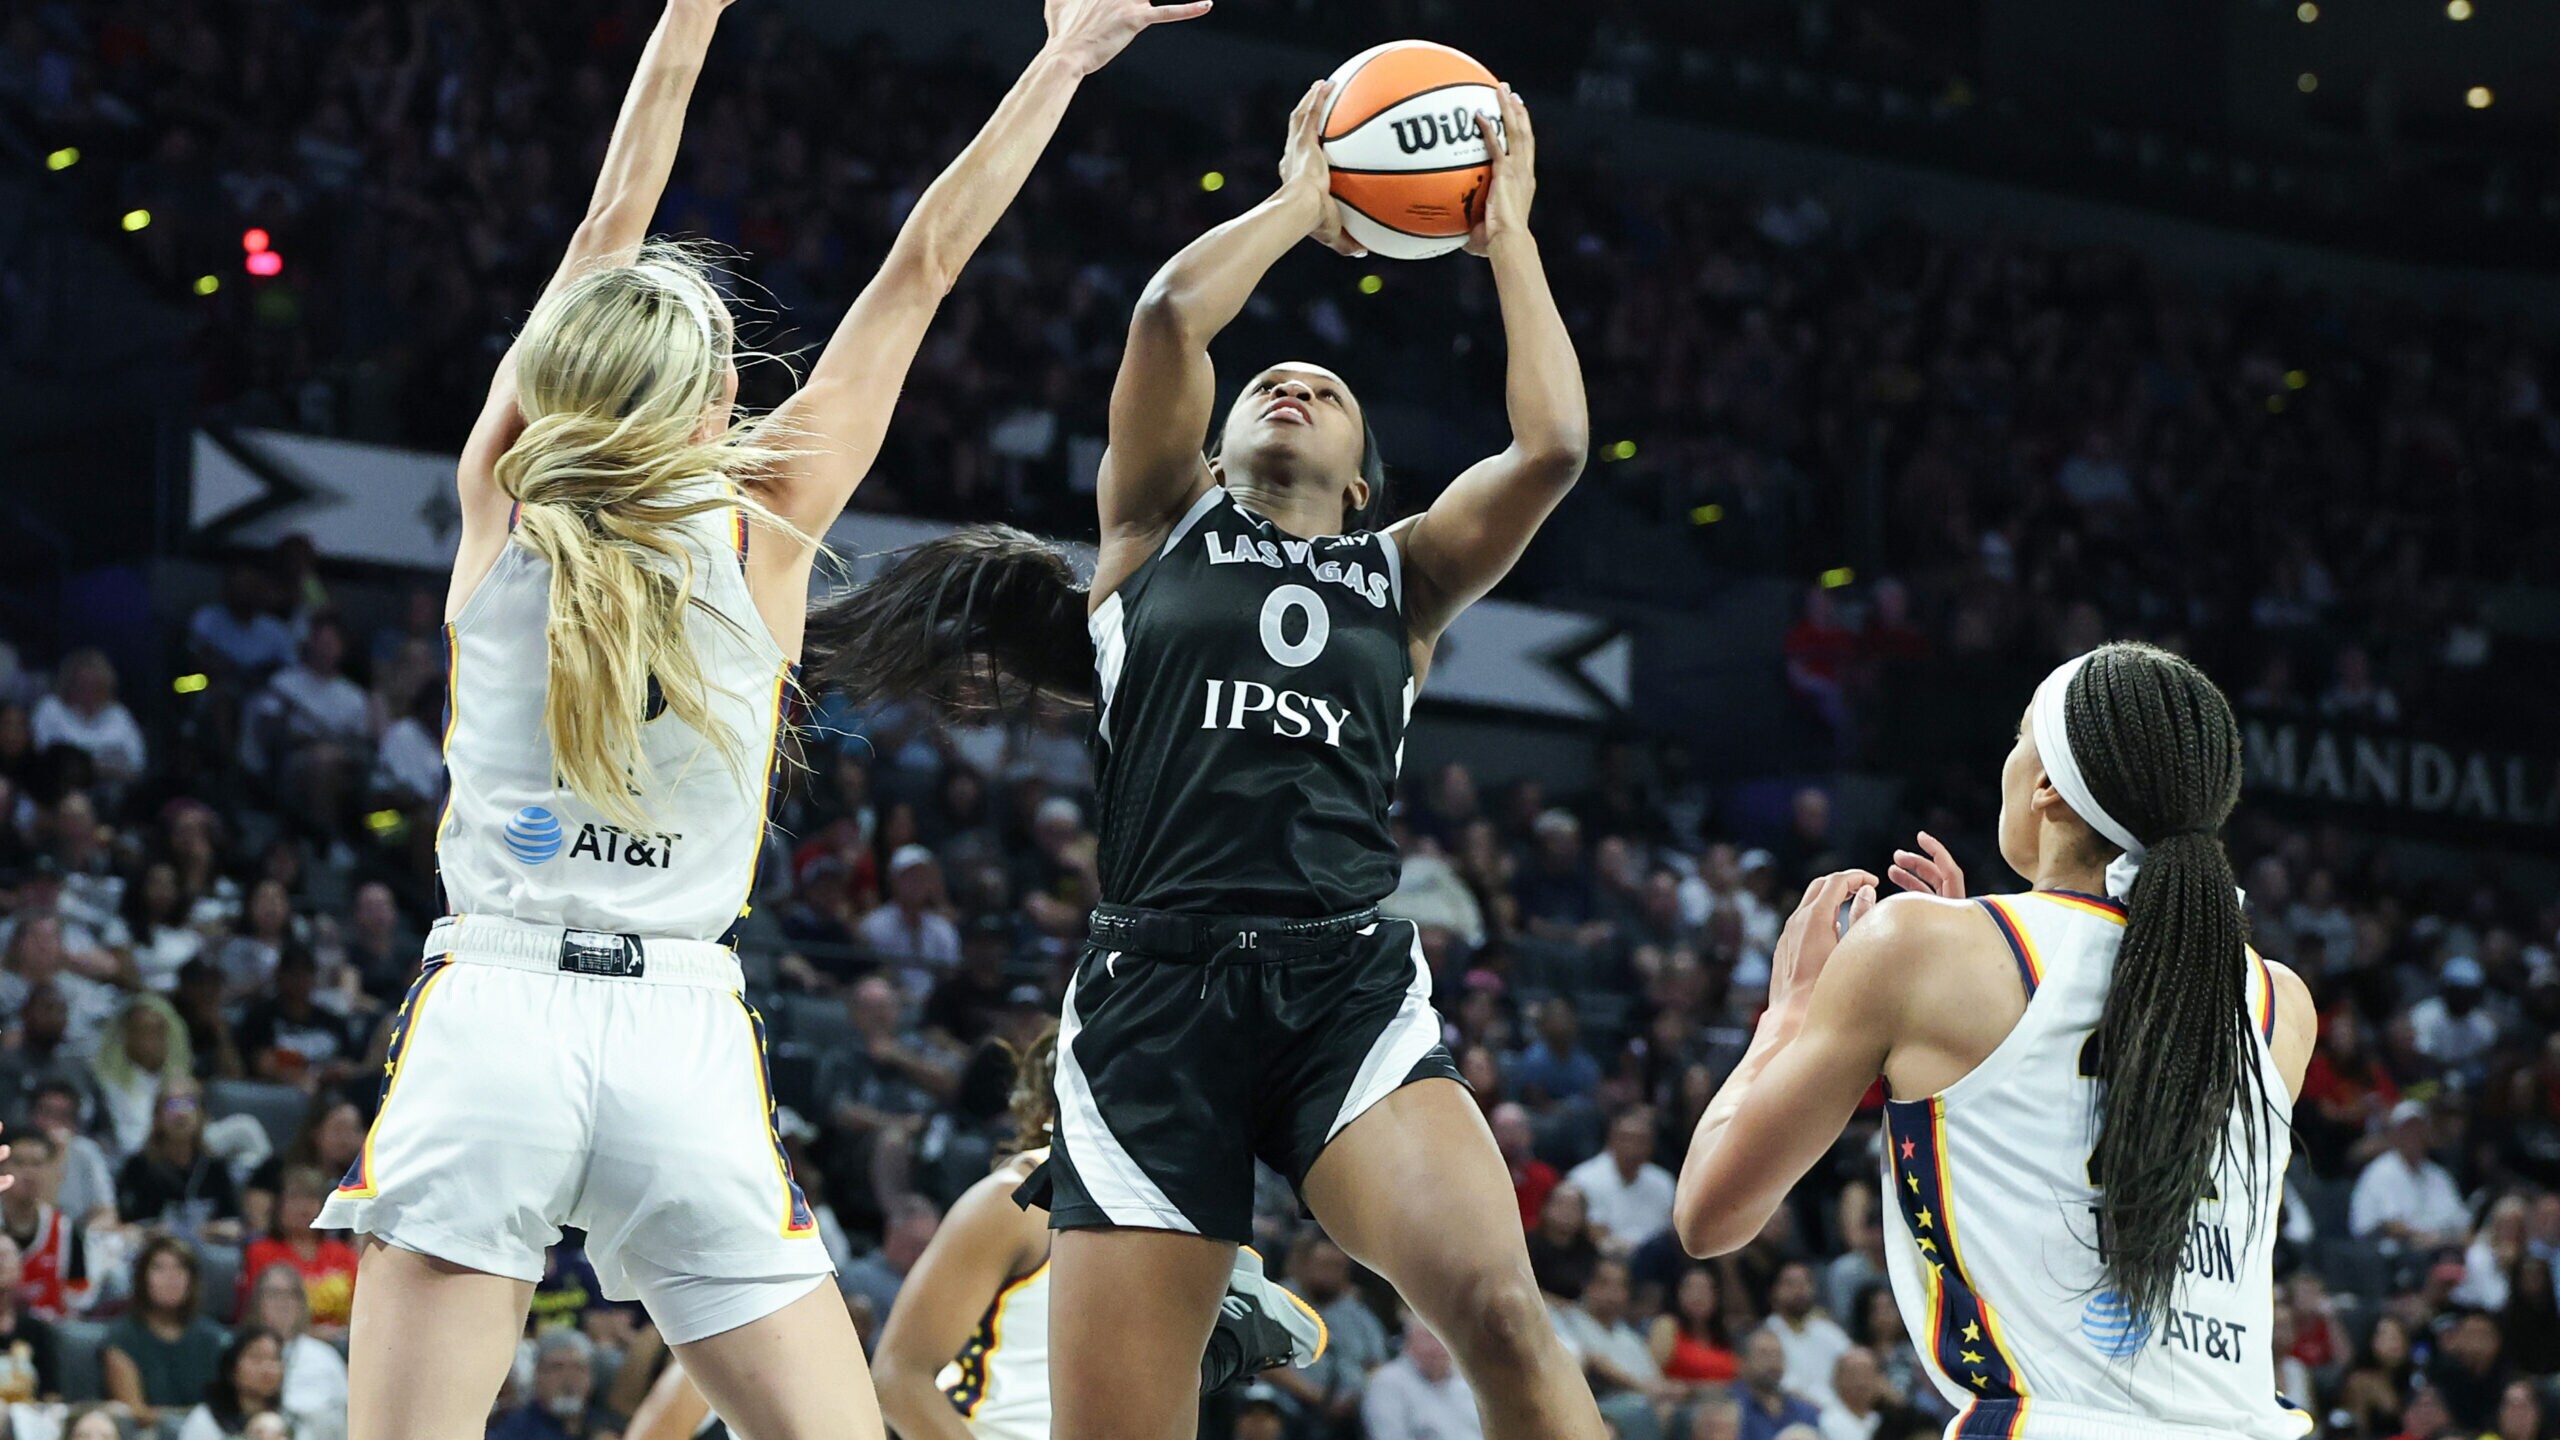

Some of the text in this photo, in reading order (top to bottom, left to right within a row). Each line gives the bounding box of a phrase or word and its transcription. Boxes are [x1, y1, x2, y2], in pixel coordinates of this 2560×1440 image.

[1204, 530, 1390, 608] LAS VGAS
[1259, 583, 1330, 667] 0
[1201, 679, 1351, 747] IPSY
[2240, 720, 2560, 826] MANDAL
[568, 823, 682, 869] AT&T
[2160, 1308, 2247, 1364] AT&T
